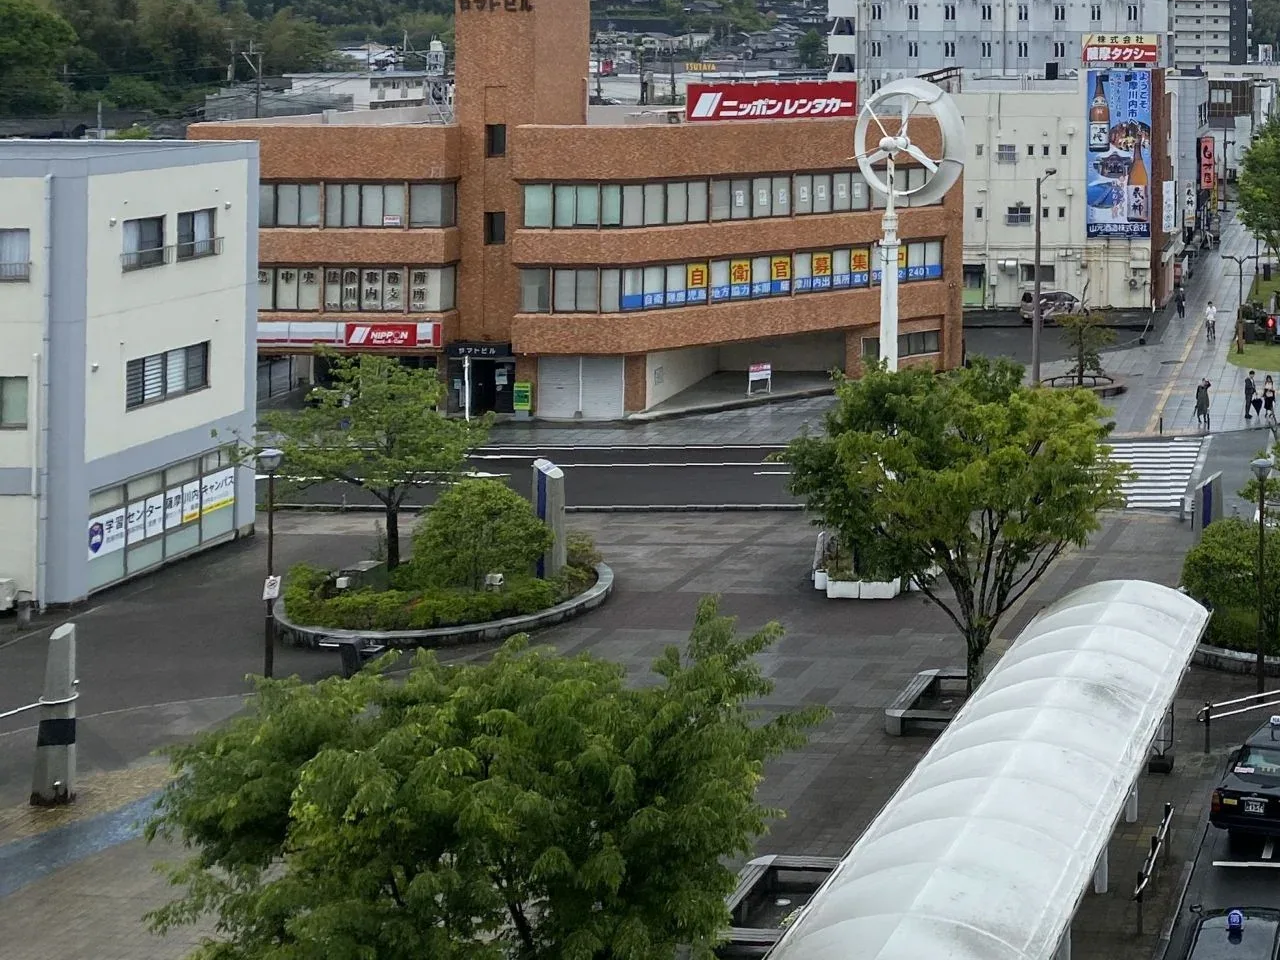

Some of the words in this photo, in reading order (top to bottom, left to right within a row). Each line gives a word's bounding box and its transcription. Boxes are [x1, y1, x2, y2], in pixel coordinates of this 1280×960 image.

[1097, 35, 1144, 44] 株式会社
[1086, 47, 1156, 61] 薩摩タクシー
[685, 63, 717, 72] TSUTAYA
[720, 97, 853, 117] ニッポンレンタカー
[370, 331, 409, 340] NIPPON
